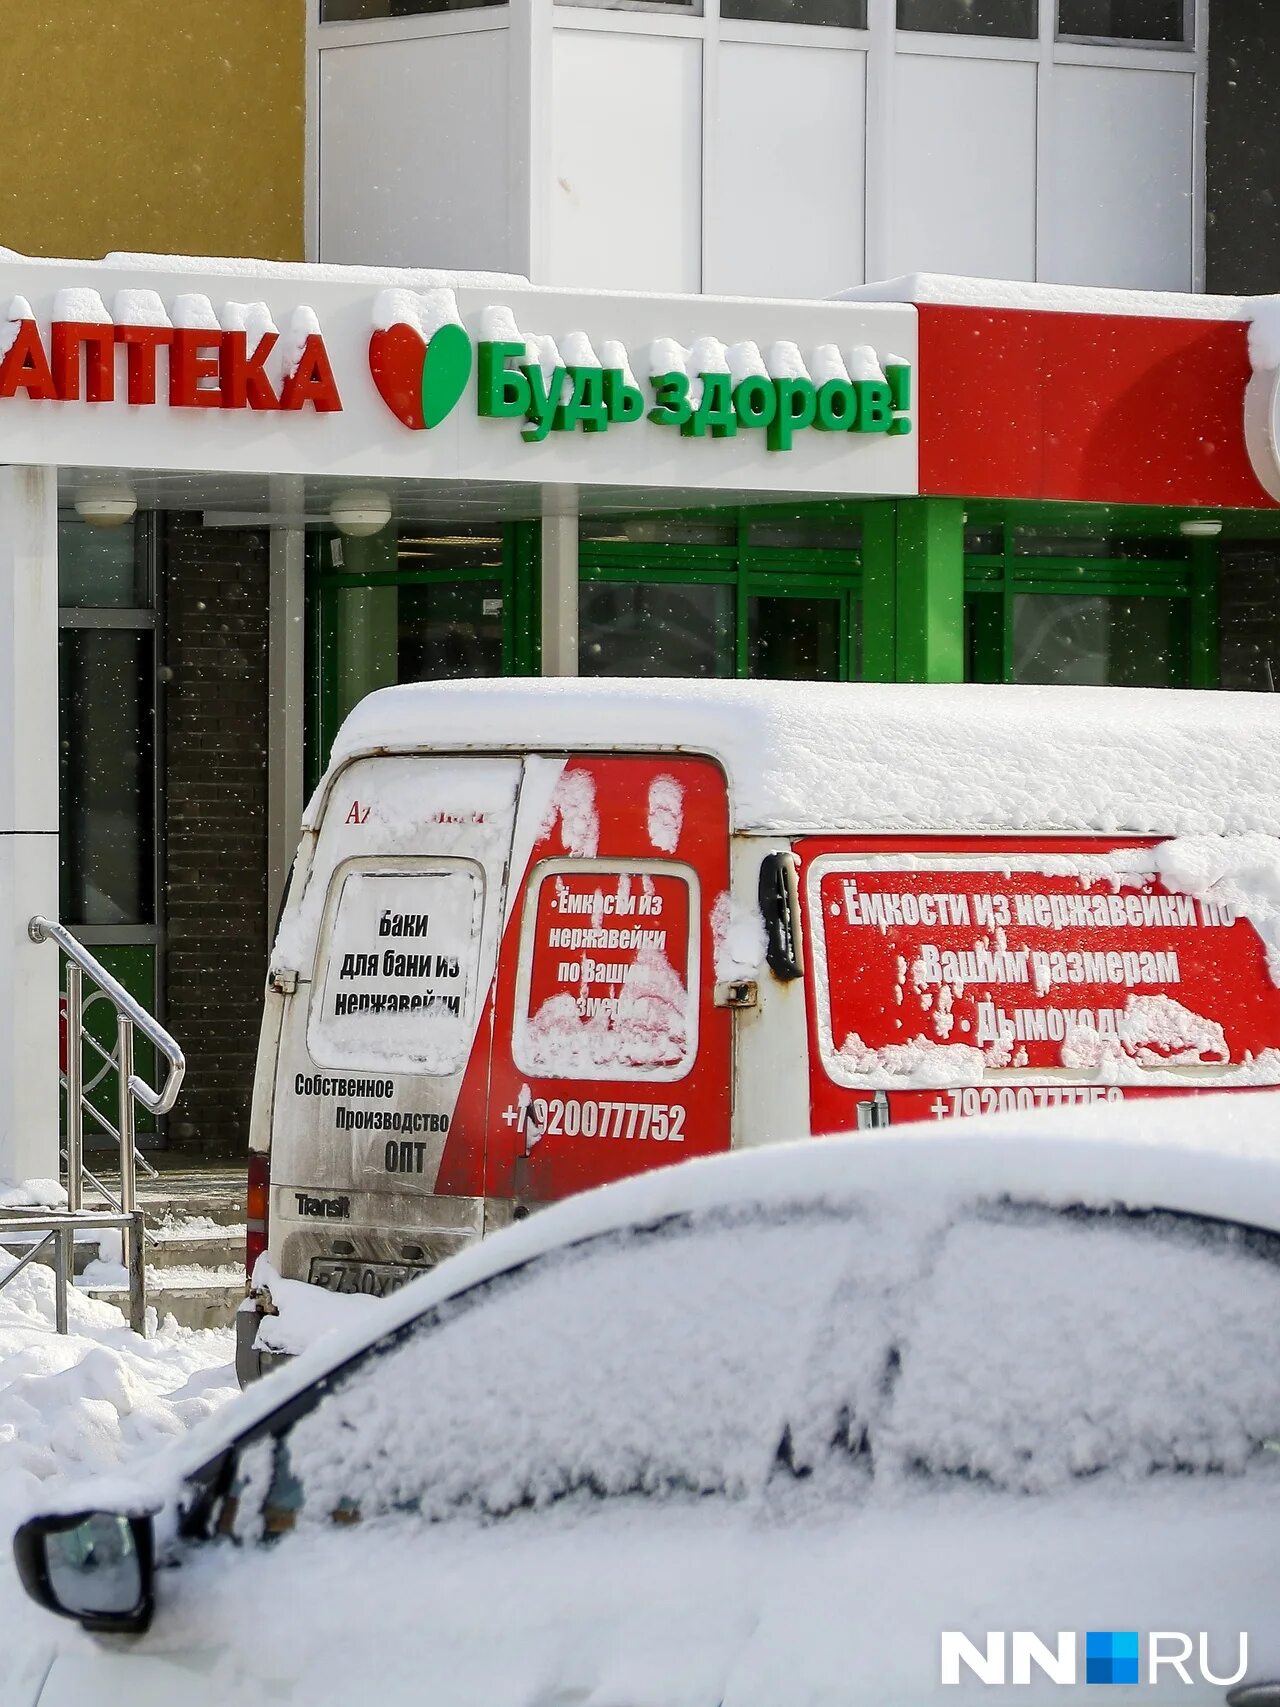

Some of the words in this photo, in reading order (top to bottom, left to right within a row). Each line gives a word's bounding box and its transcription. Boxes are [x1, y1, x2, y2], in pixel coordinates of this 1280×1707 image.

[478, 341, 644, 441] Будь
[648, 364, 912, 451] здоров!
[558, 884, 635, 916] Ёмксти
[638, 894, 663, 916] из
[843, 878, 971, 927] Ёмкости
[974, 894, 1012, 927] из
[1015, 885, 1198, 930] нержавейки
[1202, 902, 1236, 928] по
[379, 909, 429, 937] Баки
[549, 924, 667, 950] нержавейки
[340, 953, 379, 980] для
[382, 949, 432, 977] бани
[558, 961, 580, 983] по
[921, 943, 1030, 984] Вашим
[1032, 950, 1182, 988] размерам
[335, 989, 461, 1018] нержавейи
[294, 1073, 394, 1099] Собственное
[335, 1106, 450, 1134] Производство
[385, 1140, 427, 1174] ОПТ
[295, 1193, 350, 1218] Transit
